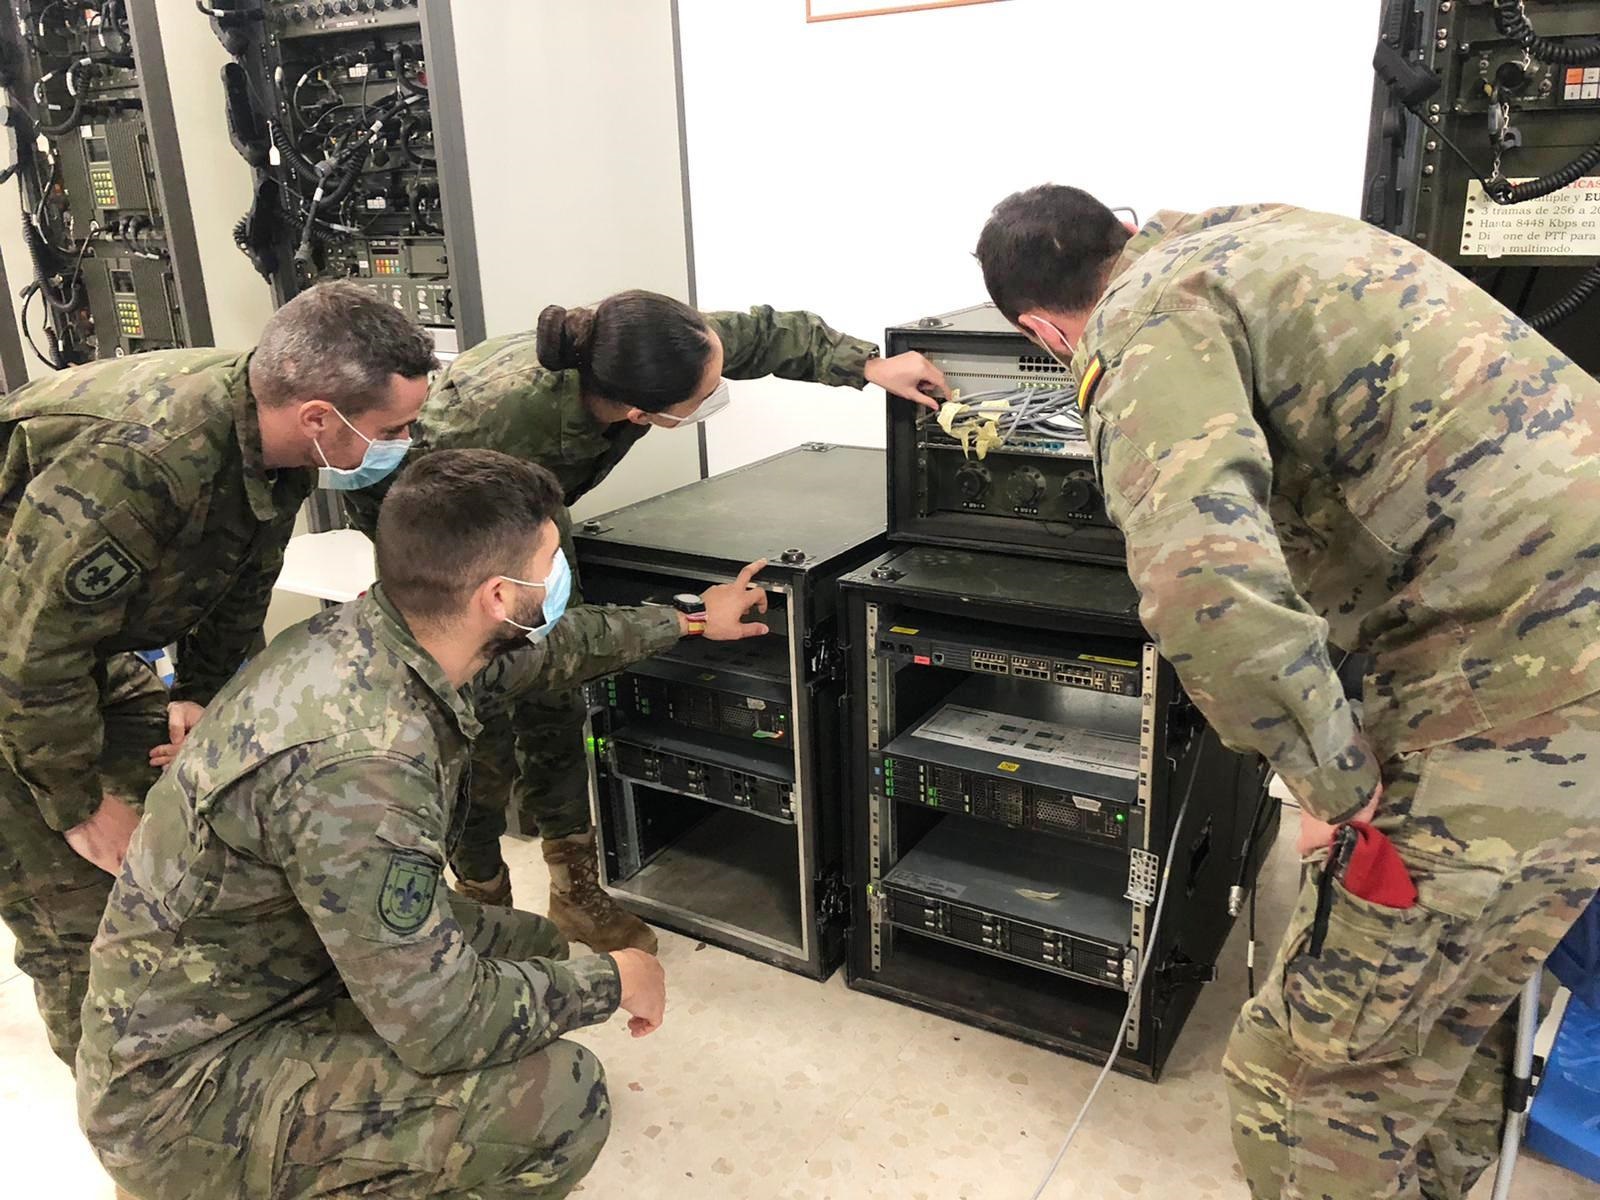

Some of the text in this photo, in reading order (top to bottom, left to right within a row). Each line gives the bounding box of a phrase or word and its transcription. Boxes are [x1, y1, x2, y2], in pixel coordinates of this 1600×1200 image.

[1573, 194, 1581, 204] y
[1481, 206, 1489, 215] 3
[1492, 207, 1531, 215] tramas
[1535, 206, 1549, 215] de
[1553, 205, 1575, 215] 256
[1516, 218, 1545, 228] 8448
[1549, 218, 1578, 230] Kbps
[1581, 220, 1596, 228] en
[1527, 231, 1540, 240] de
[1544, 231, 1567, 240] PTT
[1570, 233, 1596, 242] para
[1509, 243, 1574, 253] multimodo.
